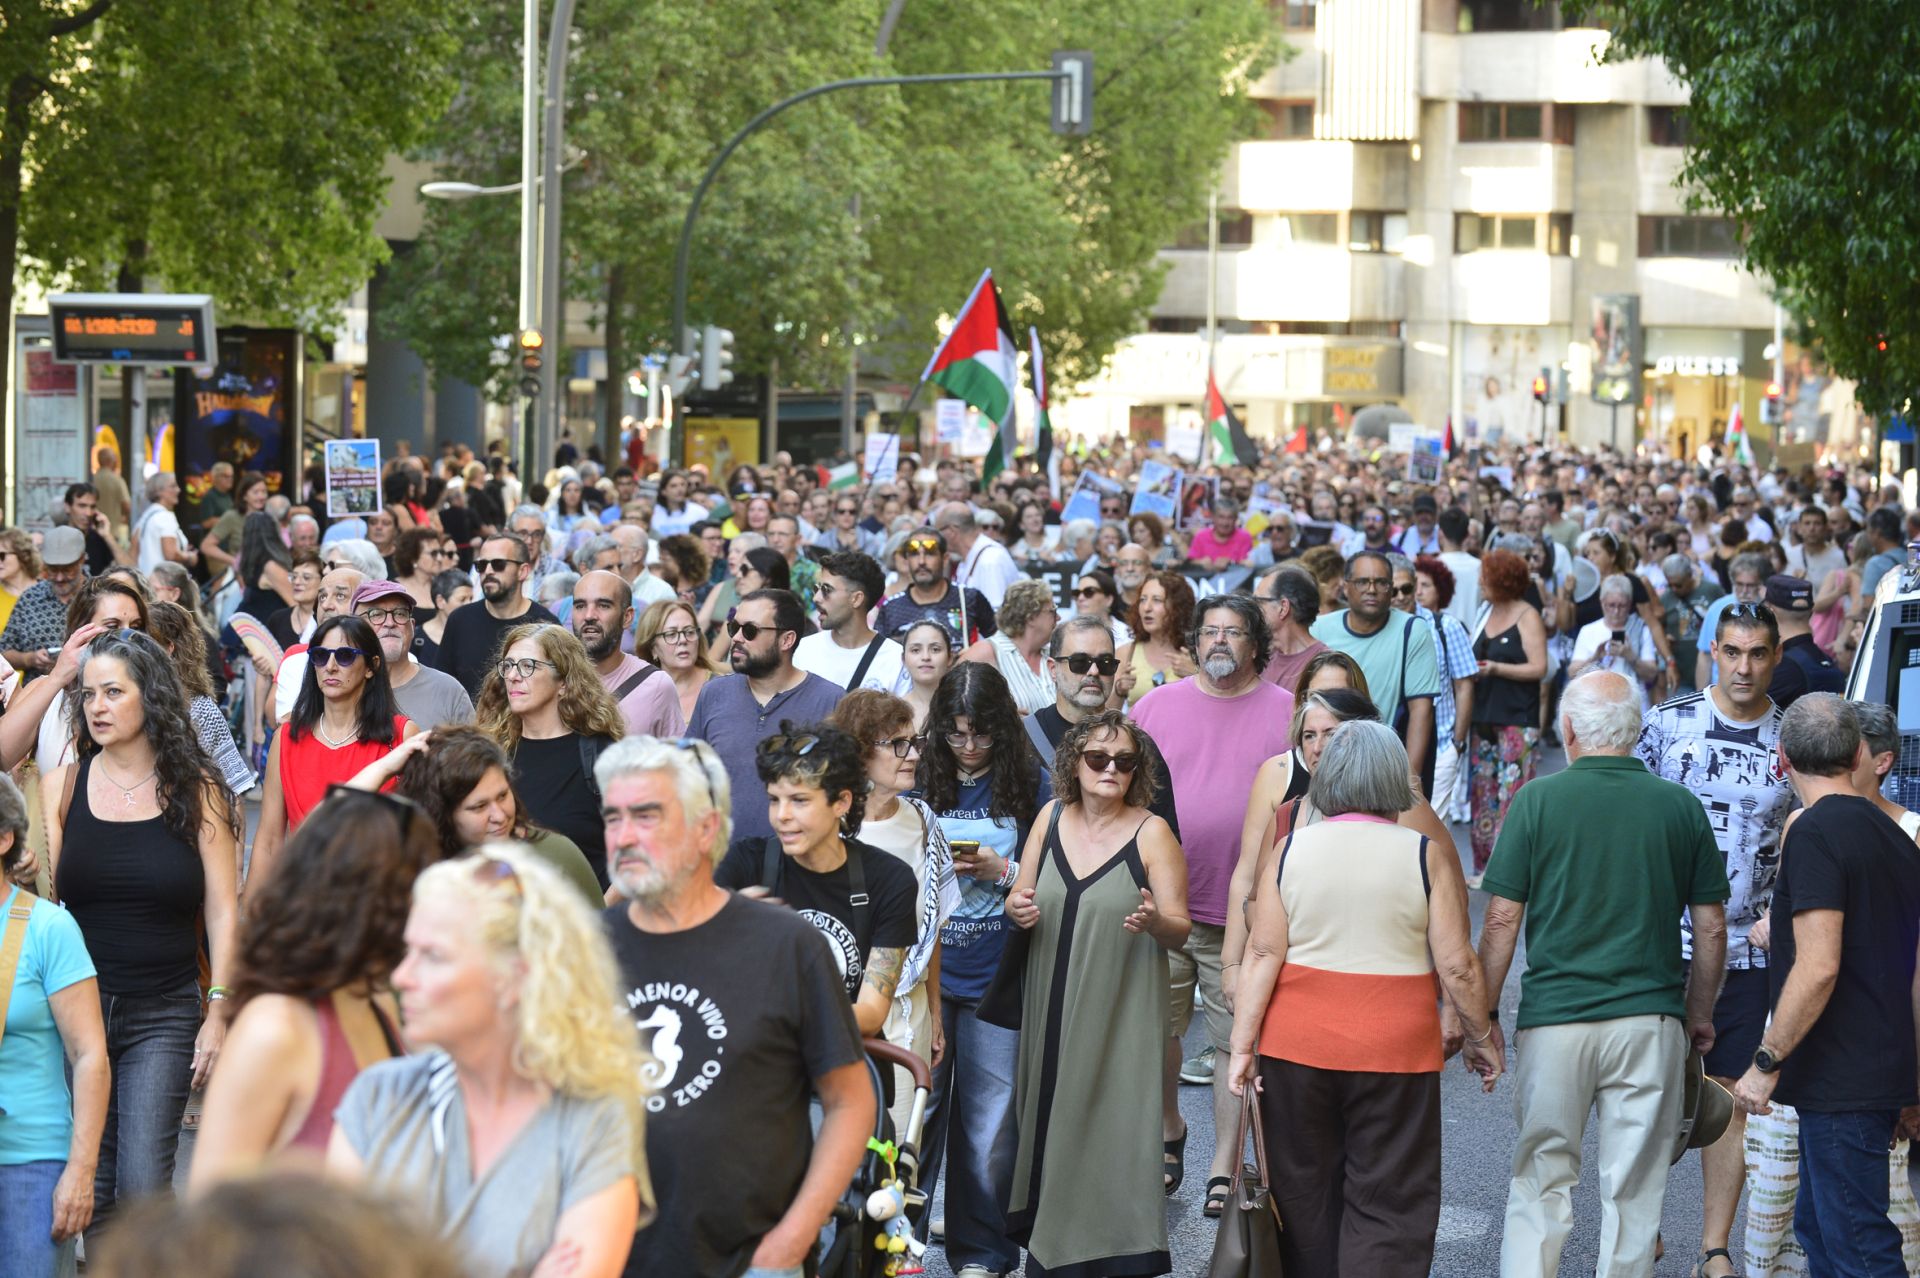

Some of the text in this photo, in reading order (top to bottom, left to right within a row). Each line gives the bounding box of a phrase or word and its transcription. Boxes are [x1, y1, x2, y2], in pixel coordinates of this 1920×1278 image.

[942, 808, 978, 819] Great
[945, 920, 1002, 934] nagawa
[626, 981, 728, 1040] MENOR VIVO
[672, 1059, 721, 1107] ZERO
